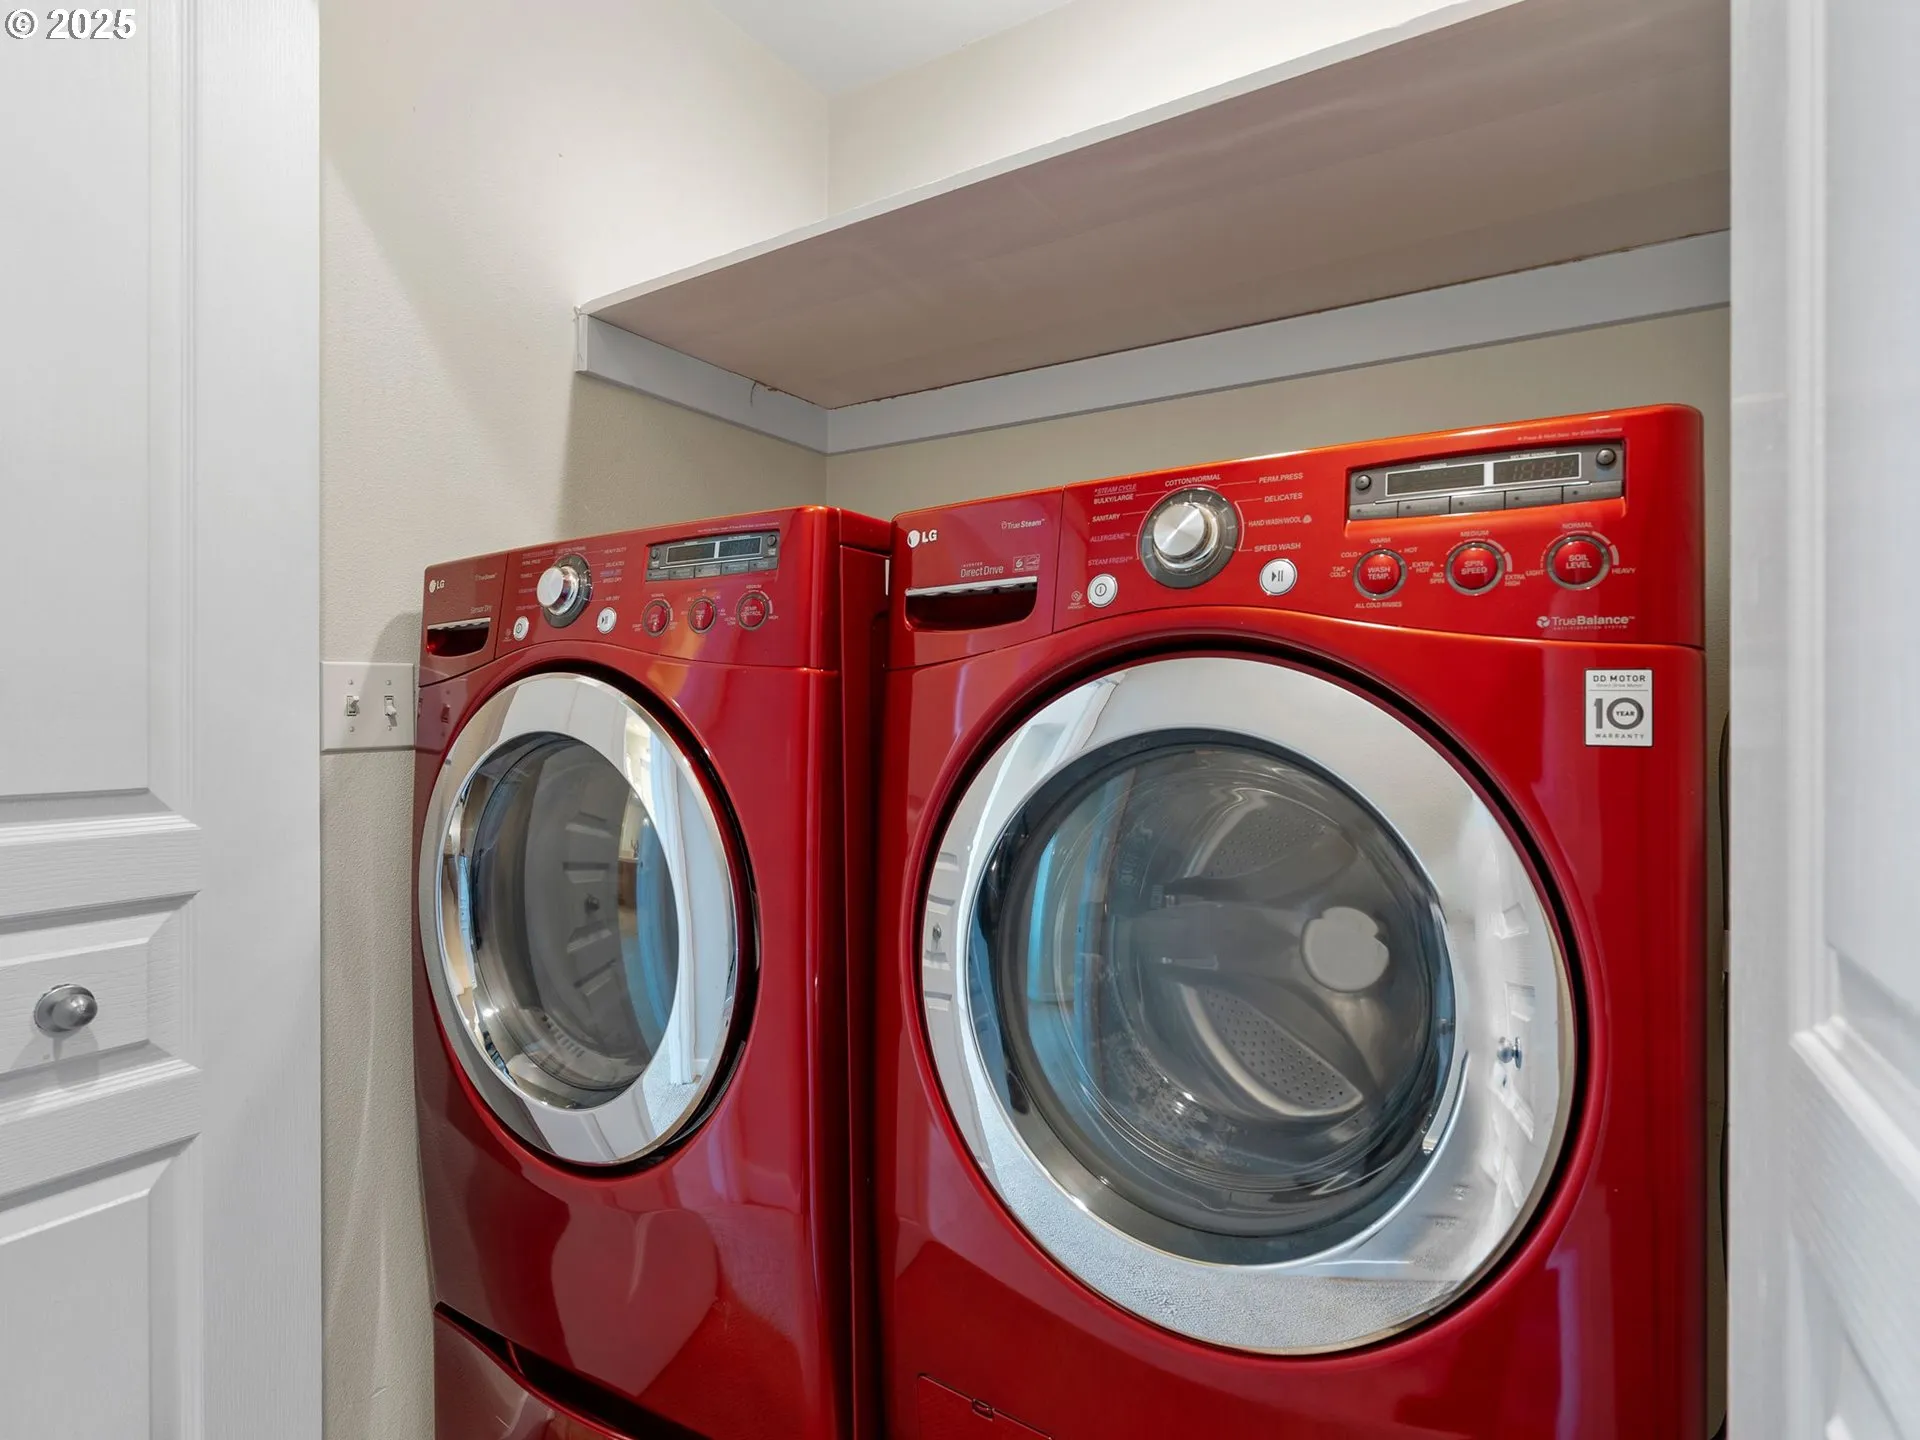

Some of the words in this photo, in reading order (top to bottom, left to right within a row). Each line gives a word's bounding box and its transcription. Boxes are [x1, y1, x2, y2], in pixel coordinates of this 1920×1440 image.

[1164, 473, 1221, 488] COTTON/NORMAL
[1264, 492, 1303, 503] DELICATES
[1092, 513, 1121, 523] SANITARY
[1248, 519, 1264, 527] HAND
[1562, 521, 1593, 529] NORMAL
[921, 529, 938, 543] LG
[1254, 543, 1277, 553] SPEED
[1278, 542, 1301, 551] WASH
[1568, 554, 1589, 562] SOIL
[1088, 558, 1110, 567] STEAM
[1464, 560, 1484, 568] SPIN
[1565, 561, 1592, 569] LEVEL
[960, 567, 983, 578] Direct
[983, 565, 1004, 576] Drive
[1461, 567, 1488, 575] SPEED
[1525, 569, 1545, 577] LIGHT
[1611, 567, 1636, 575] HEAVY
[437, 579, 445, 590] LG
[1592, 674, 1607, 682] DD
[1609, 674, 1646, 682] MOTOR
[1593, 697, 1644, 730] 10
